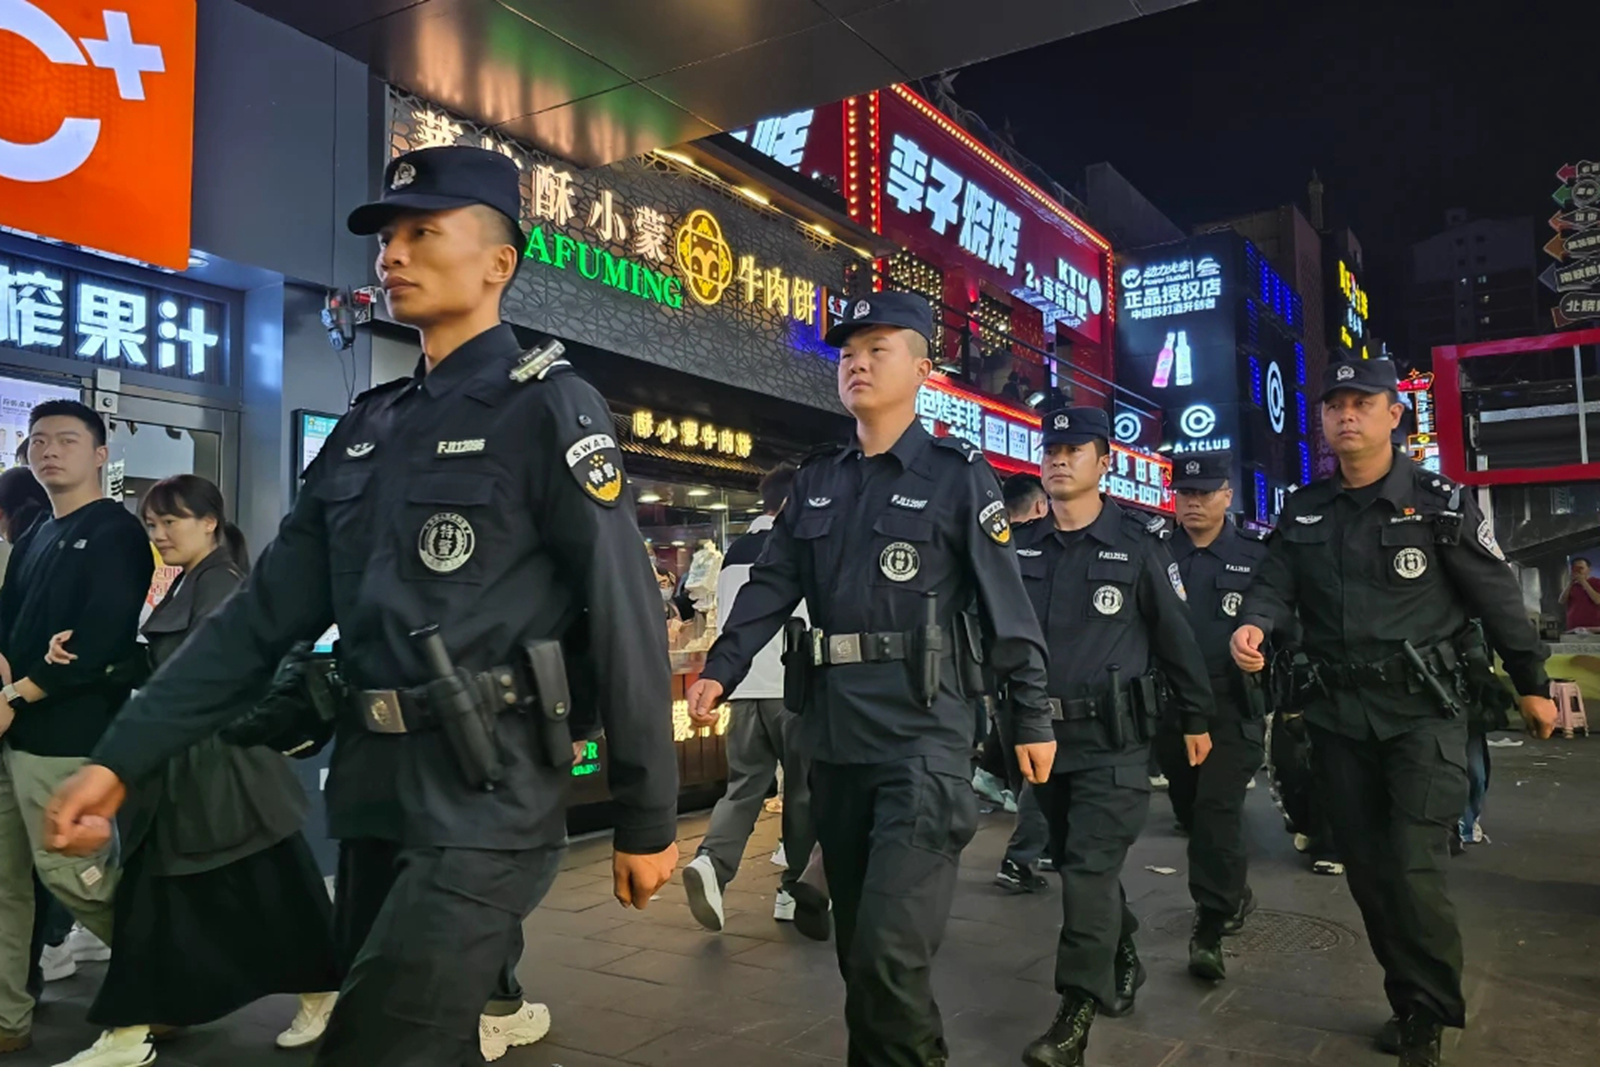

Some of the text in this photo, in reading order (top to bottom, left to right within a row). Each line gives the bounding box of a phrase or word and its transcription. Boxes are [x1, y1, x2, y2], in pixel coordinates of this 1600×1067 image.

[886, 133, 1022, 277] 李子烧烤
[738, 255, 817, 327] 牛肉饼
[1124, 278, 1221, 310] 正品授权店
[572, 436, 607, 459] SWAT
